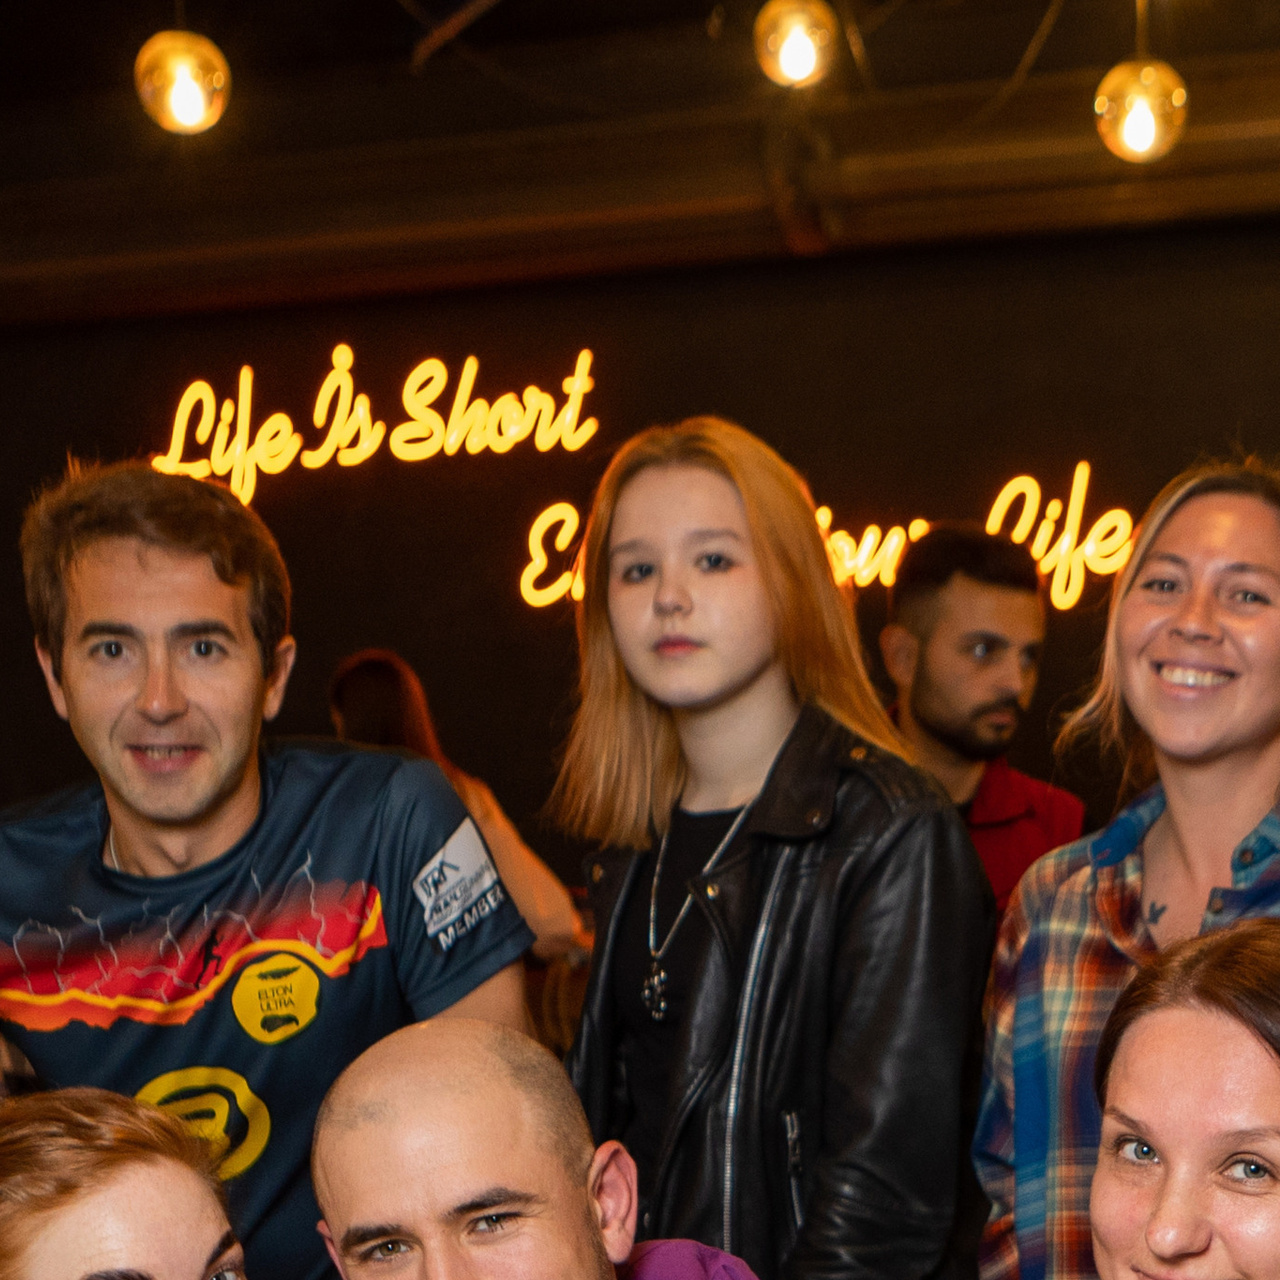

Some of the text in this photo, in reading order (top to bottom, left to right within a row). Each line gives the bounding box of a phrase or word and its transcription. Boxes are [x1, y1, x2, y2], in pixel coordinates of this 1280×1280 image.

[151, 366, 302, 507] Life
[390, 349, 600, 462] Short
[258, 984, 293, 1001] ELTON
[260, 997, 295, 1013] ULTRA
